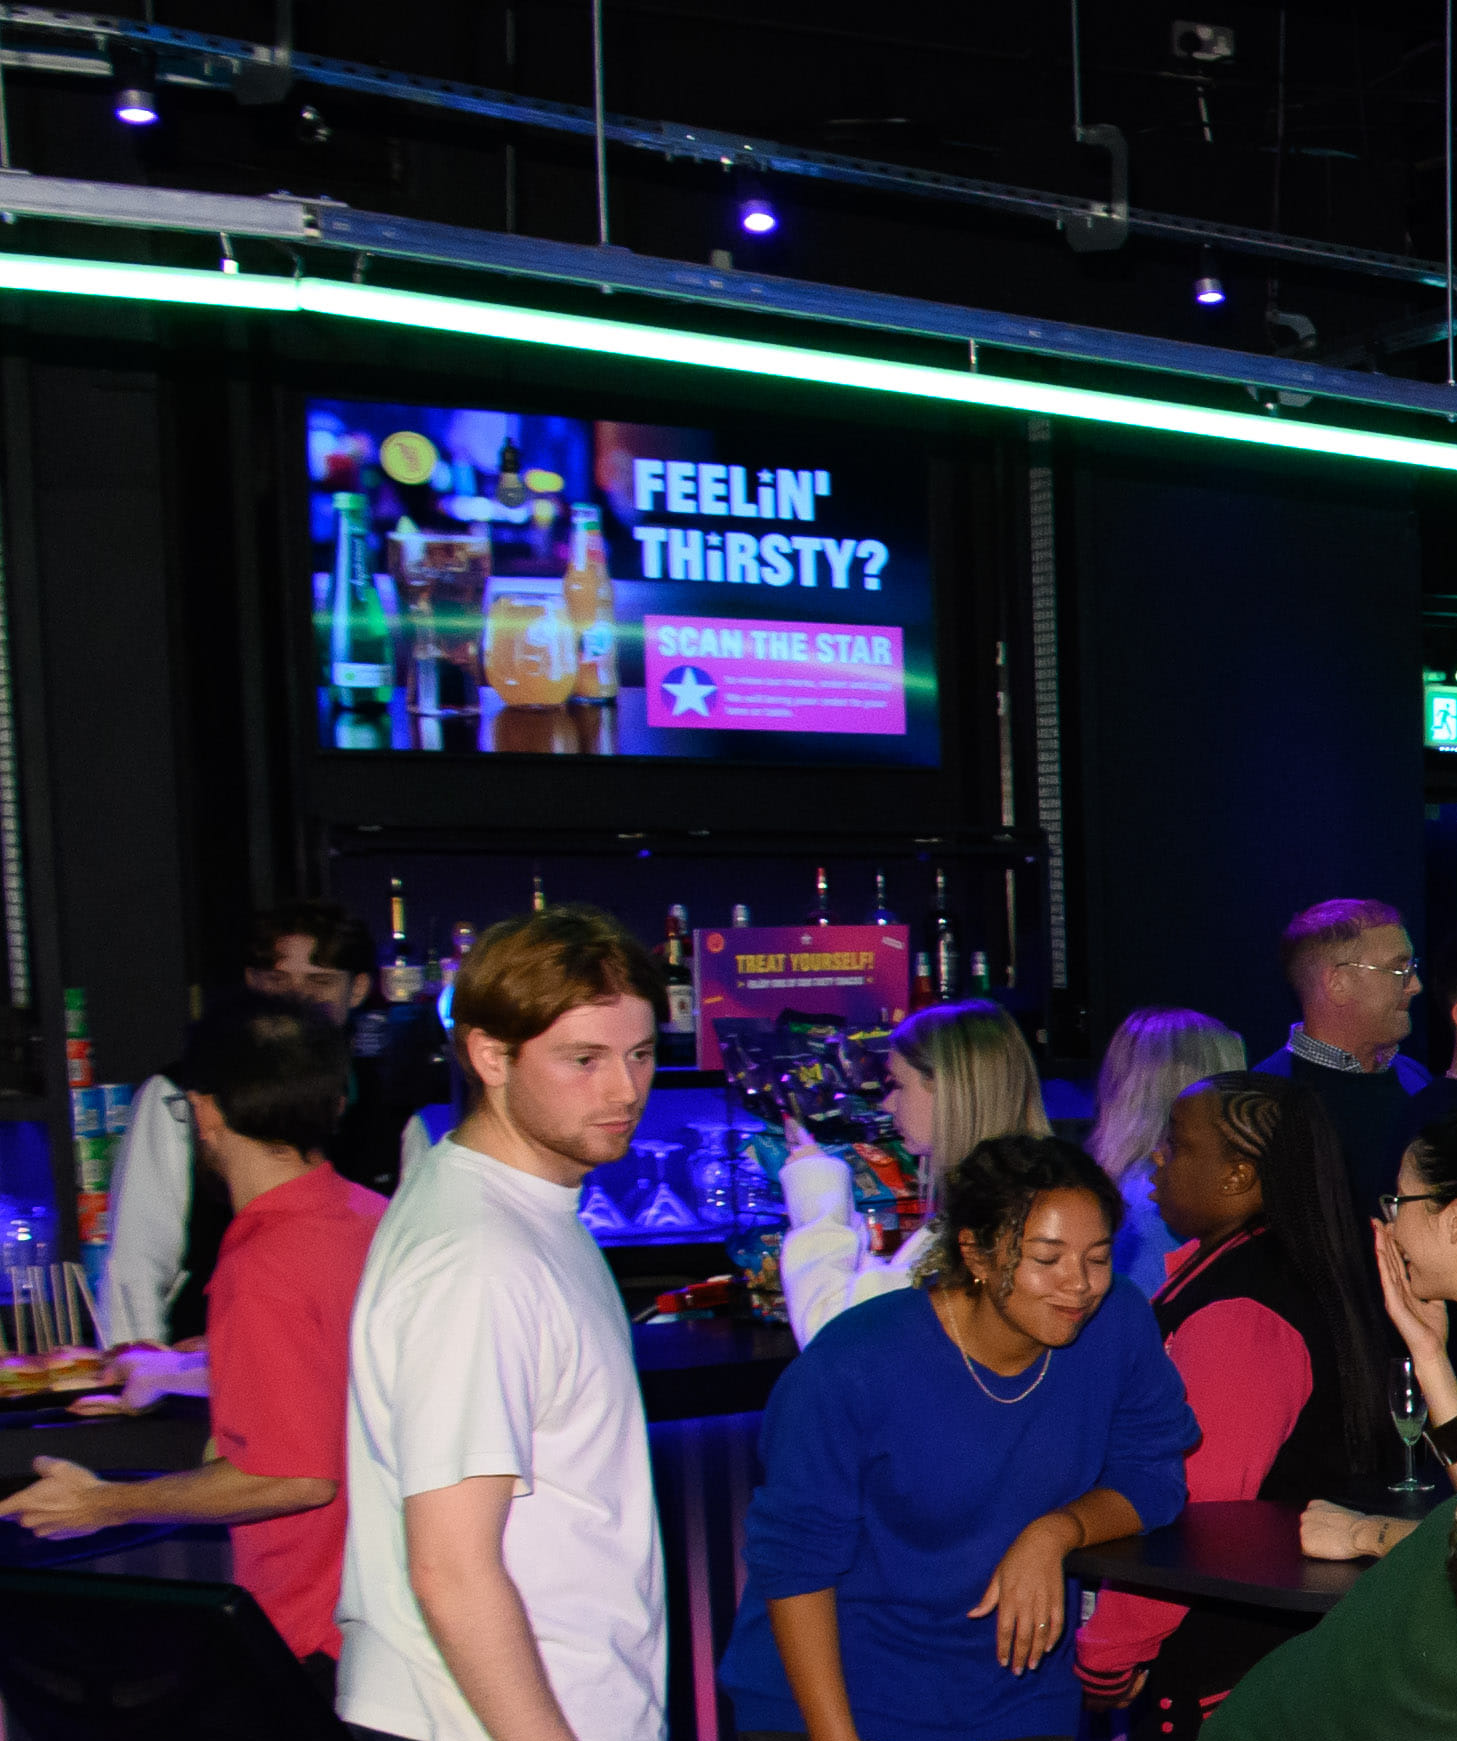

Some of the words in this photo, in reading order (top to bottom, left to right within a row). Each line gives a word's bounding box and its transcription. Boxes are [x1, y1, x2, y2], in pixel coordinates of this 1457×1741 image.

[656, 625, 744, 660] SCAN
[750, 630, 808, 663] THE
[815, 633, 892, 665] STAR
[735, 954, 786, 973] TREAT
